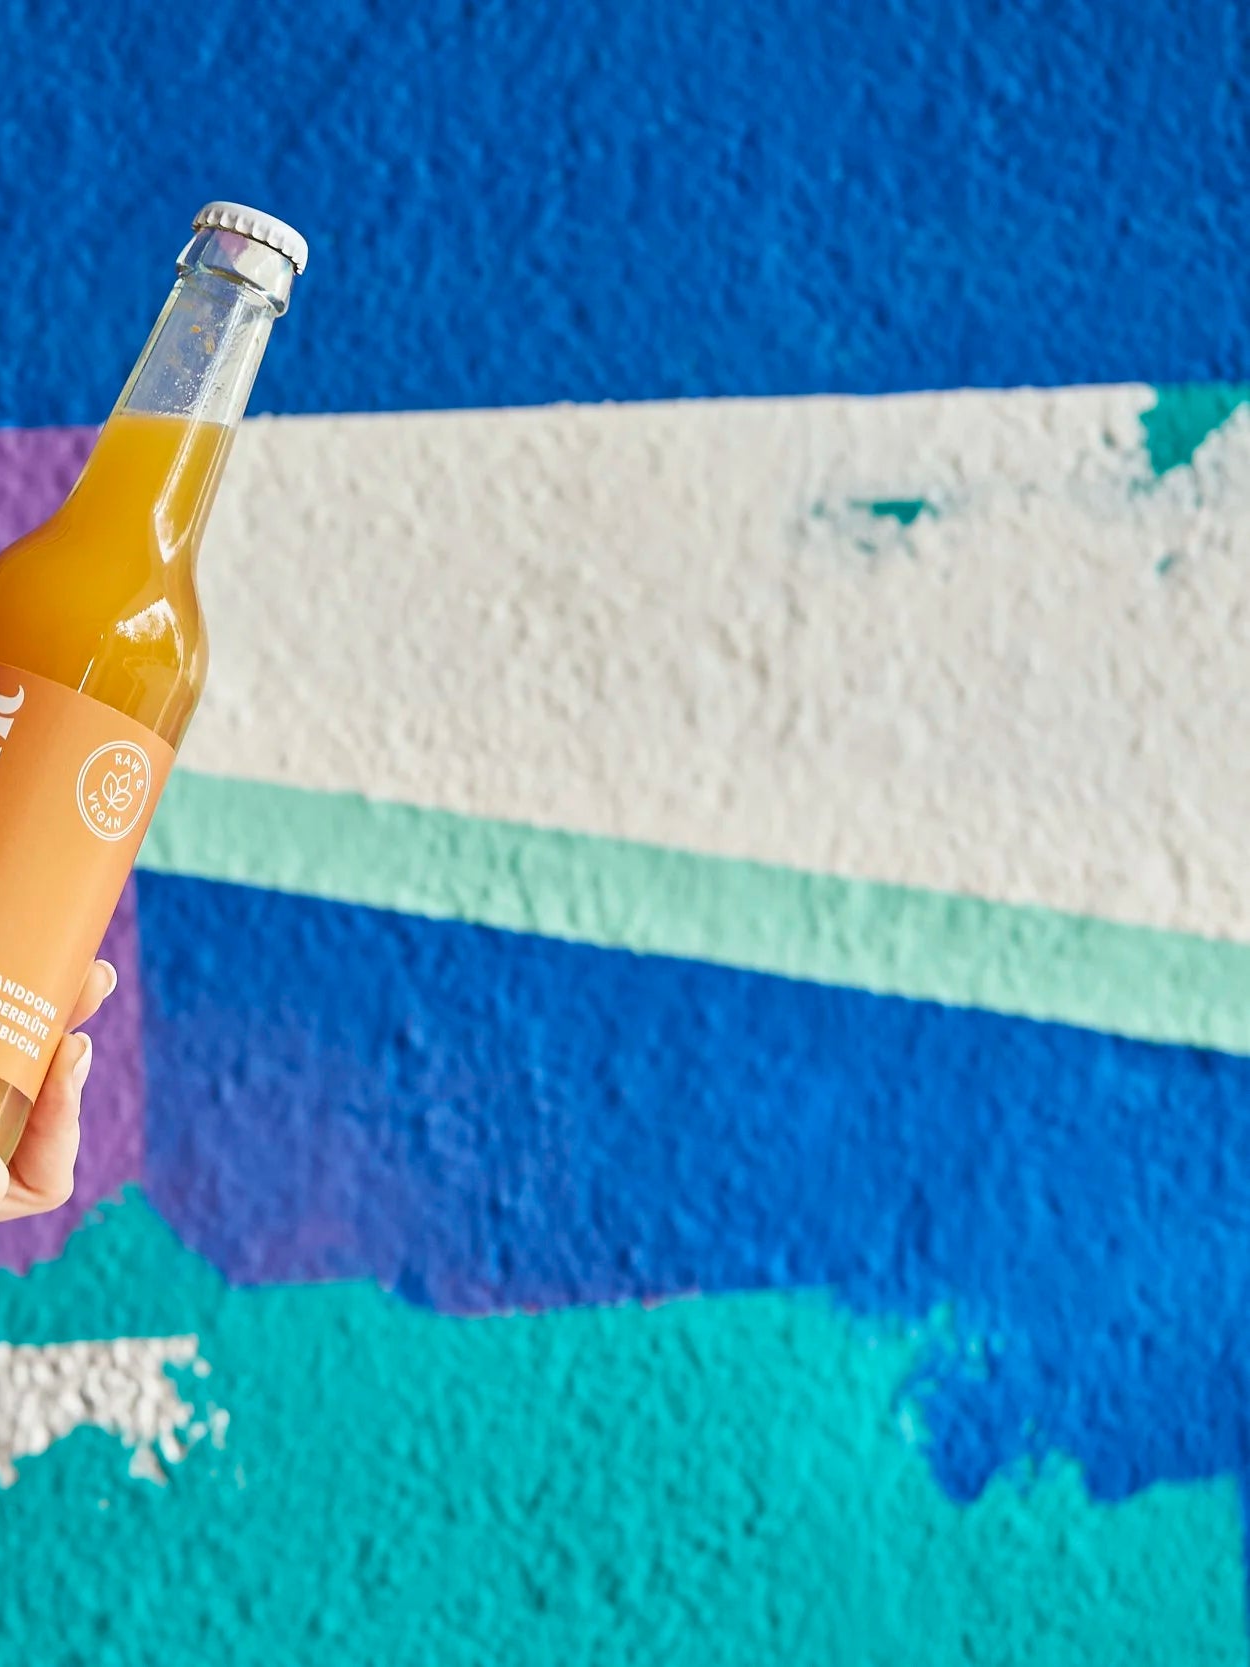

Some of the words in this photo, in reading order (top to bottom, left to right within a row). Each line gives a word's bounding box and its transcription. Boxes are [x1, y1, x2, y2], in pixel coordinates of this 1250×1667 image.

[114, 752, 142, 775] RAW
[135, 779, 145, 792] &
[87, 790, 122, 830] VEGAN
